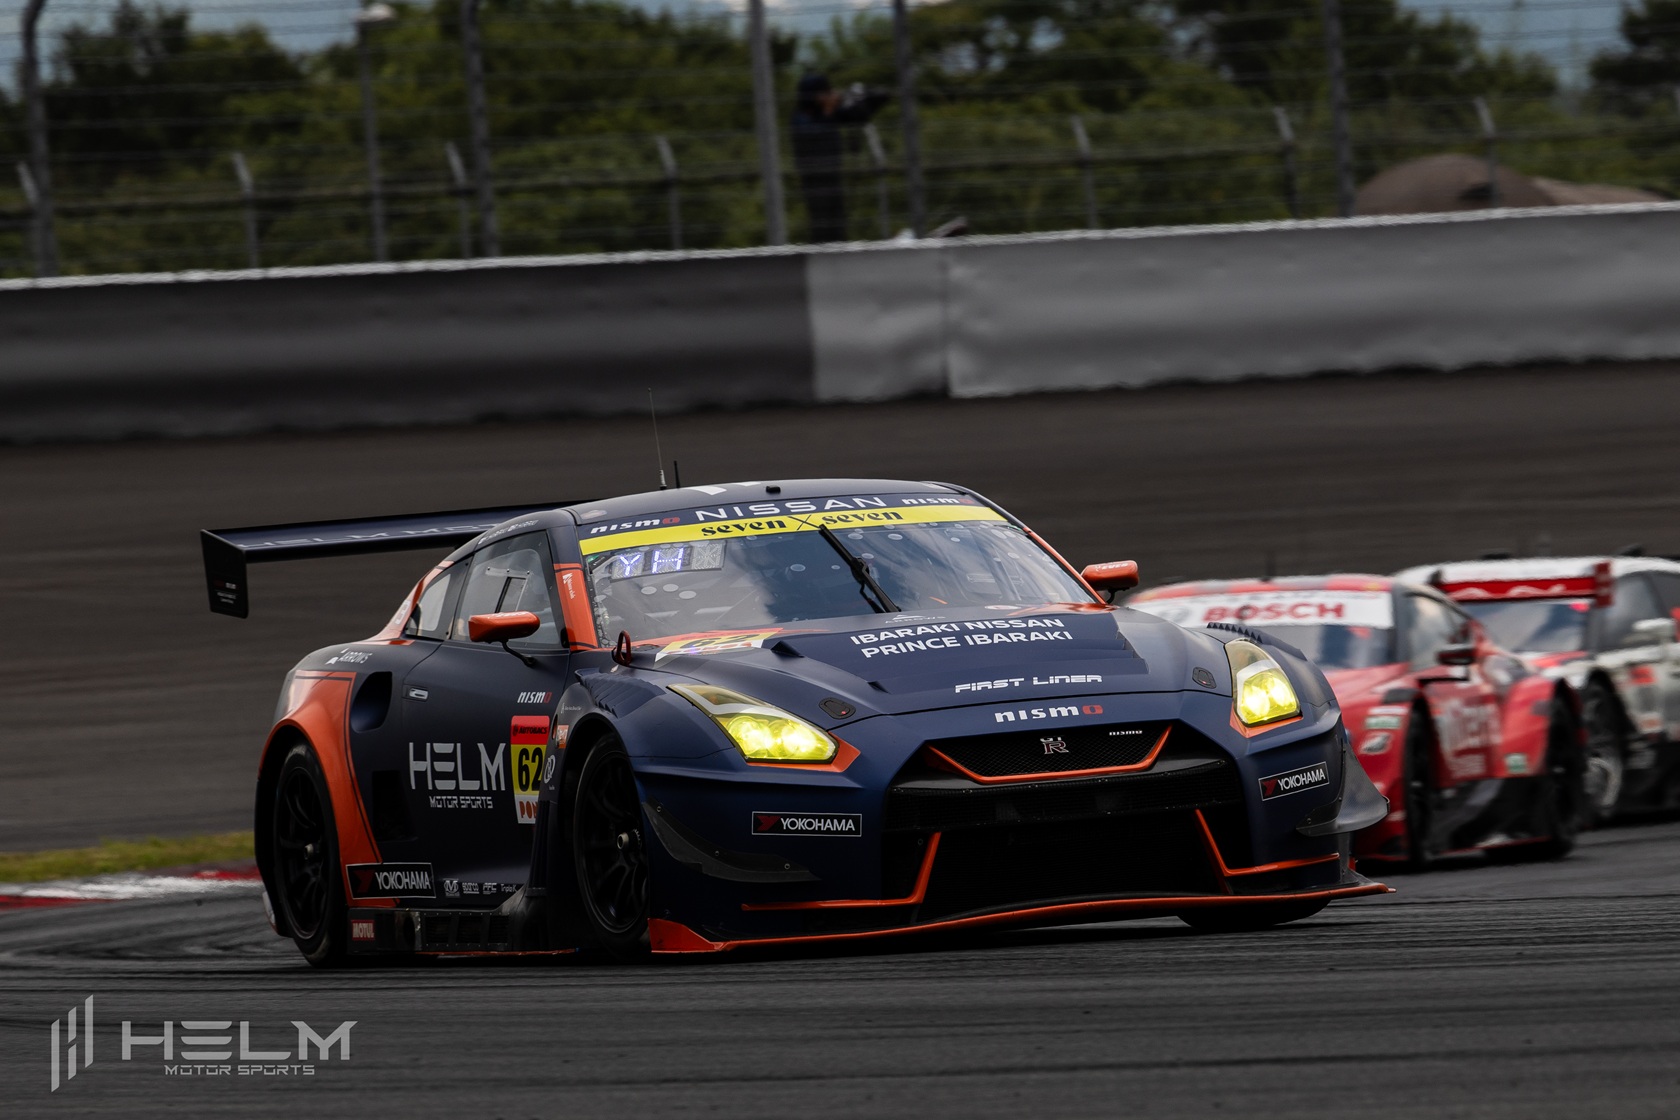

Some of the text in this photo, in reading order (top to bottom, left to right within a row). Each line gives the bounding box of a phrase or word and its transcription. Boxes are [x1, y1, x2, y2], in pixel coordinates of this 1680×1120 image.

[590, 496, 975, 534] nismo NISSAN nismo
[701, 517, 787, 537] seven
[821, 510, 904, 525] seven
[1202, 601, 1345, 622] BOSCH
[850, 618, 1065, 645] IBARAKI NISSAN
[861, 630, 1073, 658] PRINCE IBARAKI
[955, 674, 1102, 693] FIRST LINER
[517, 691, 552, 704] nismo
[994, 704, 1104, 723] nismo
[409, 742, 506, 791] HELM
[518, 747, 544, 792] 62
[1277, 768, 1326, 791] YOKOHAMA
[429, 795, 494, 809] MOTOR SPORTS
[780, 818, 855, 831] YOKOHAMA
[375, 871, 431, 890] YOKOHAMA
[352, 922, 375, 939] MOTUL
